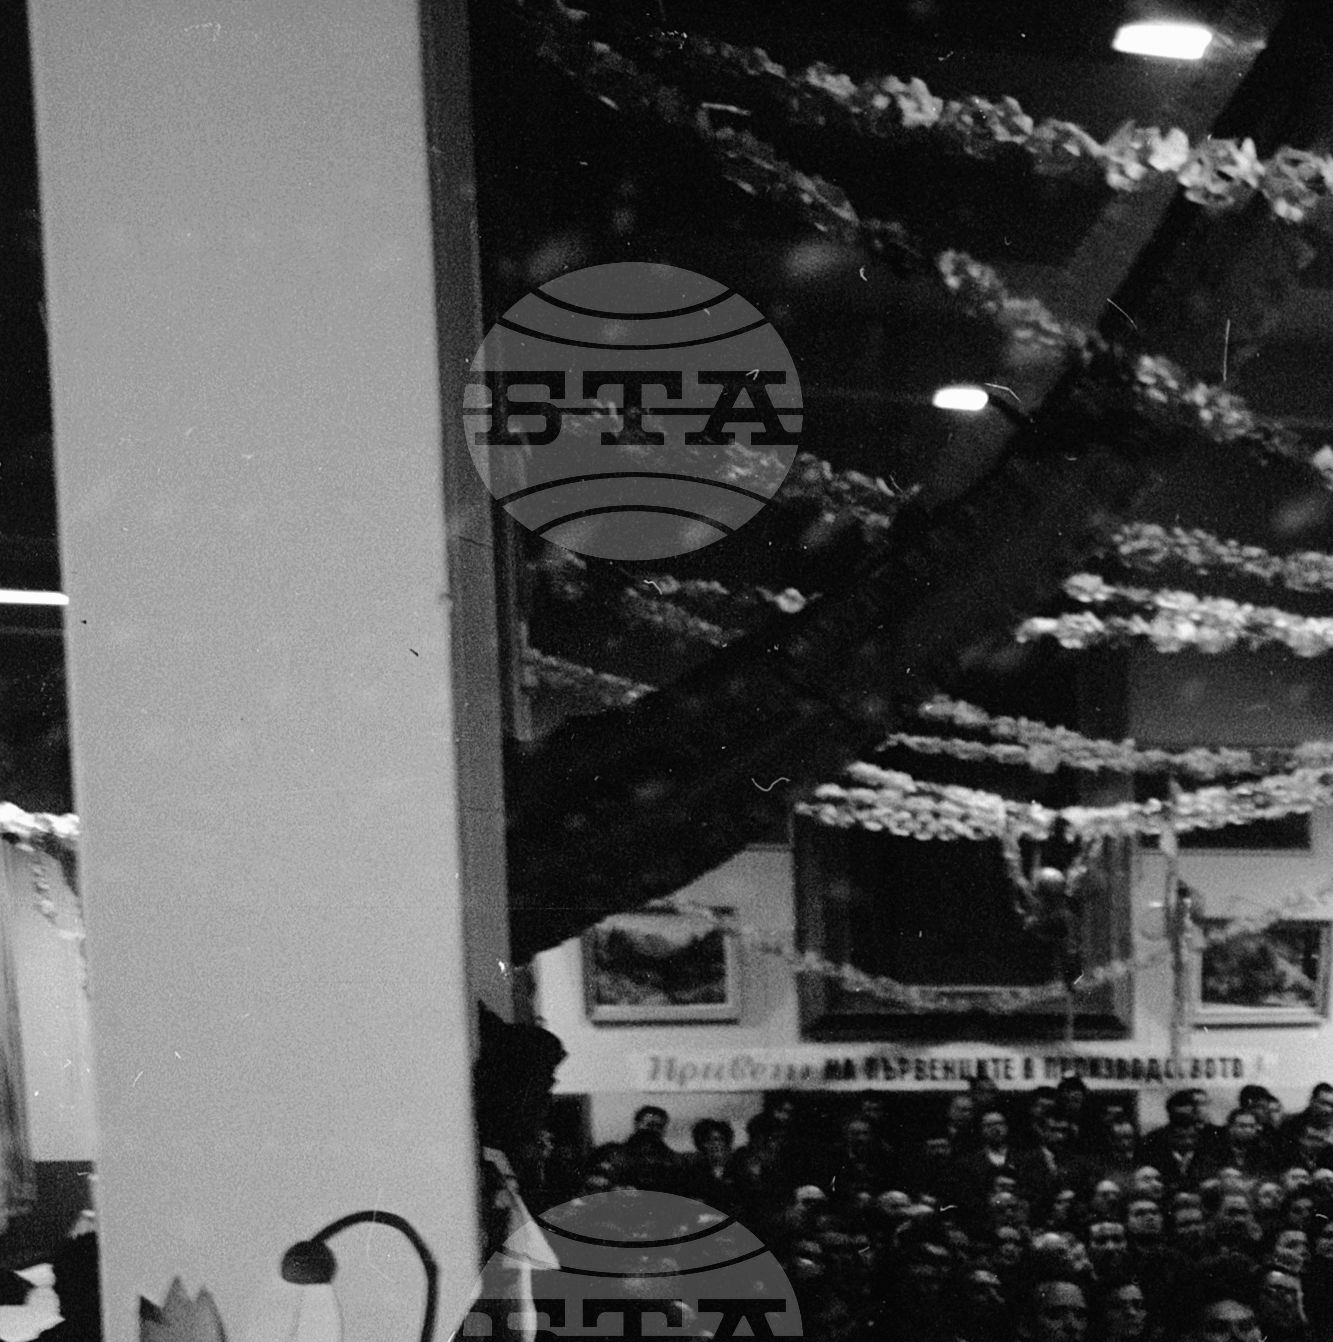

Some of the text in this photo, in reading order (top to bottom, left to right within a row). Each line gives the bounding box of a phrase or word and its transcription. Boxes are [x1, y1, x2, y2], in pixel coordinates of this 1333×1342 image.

[824, 1057, 856, 1081] НА
[863, 1056, 1013, 1082] ПЪРВЕНЦИТЕ
[1022, 1056, 1034, 1081] В
